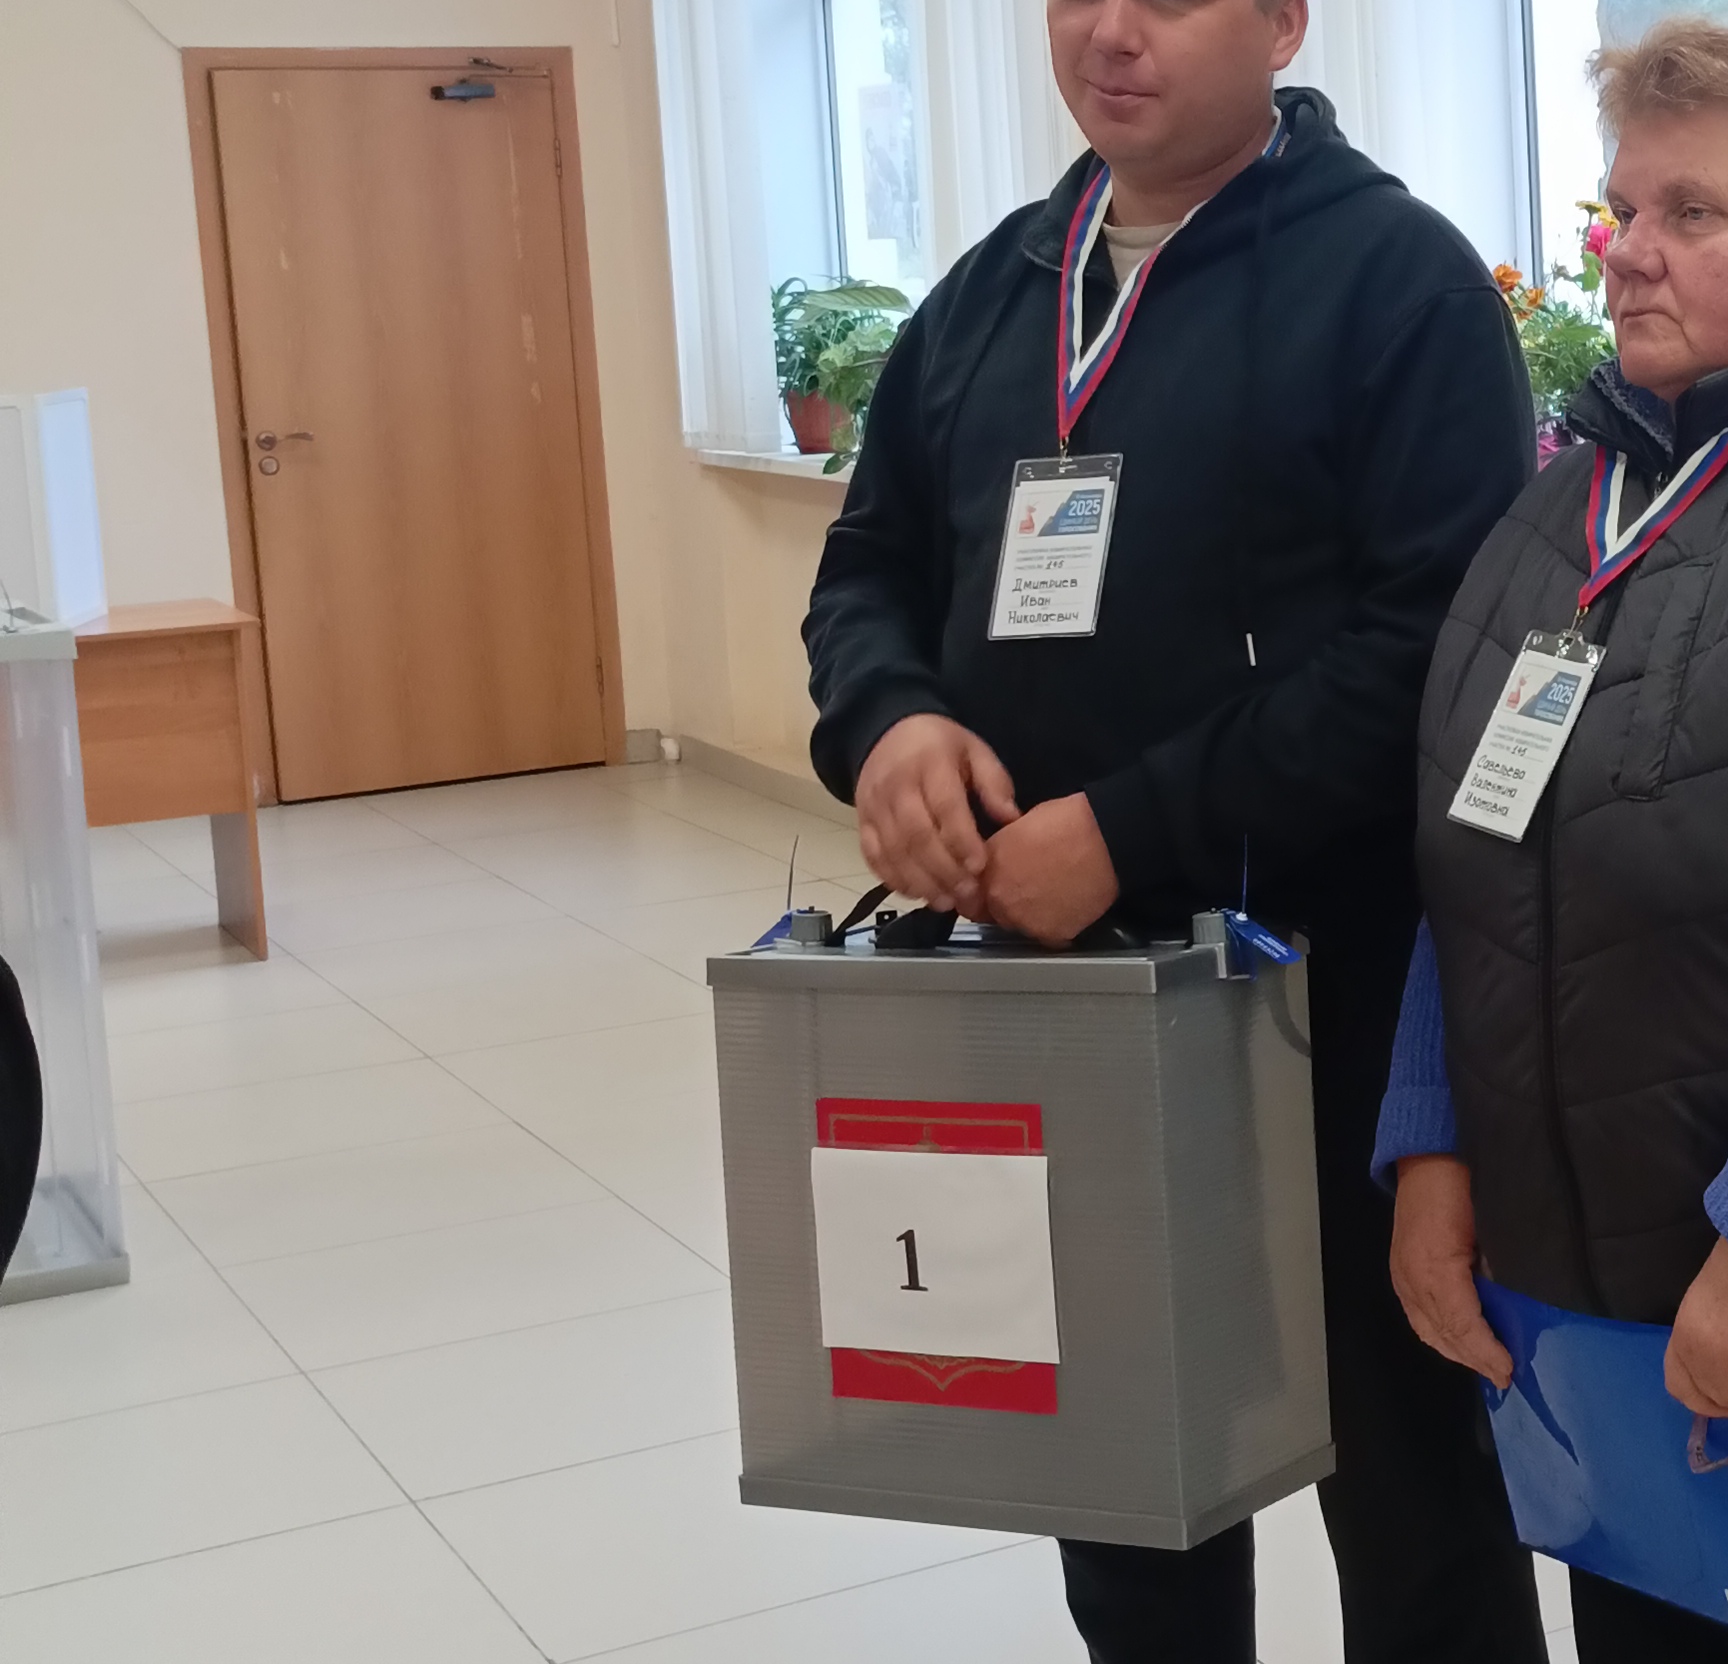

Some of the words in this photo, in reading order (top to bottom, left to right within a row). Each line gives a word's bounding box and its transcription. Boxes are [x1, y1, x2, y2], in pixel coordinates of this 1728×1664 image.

[1068, 499, 1101, 517] 2025
[1012, 578, 1078, 592] Дмитриев
[1020, 595, 1051, 607] Иван
[1008, 610, 1079, 624] Николаевич
[1547, 682, 1575, 704] 2025
[897, 1228, 929, 1291] 1
